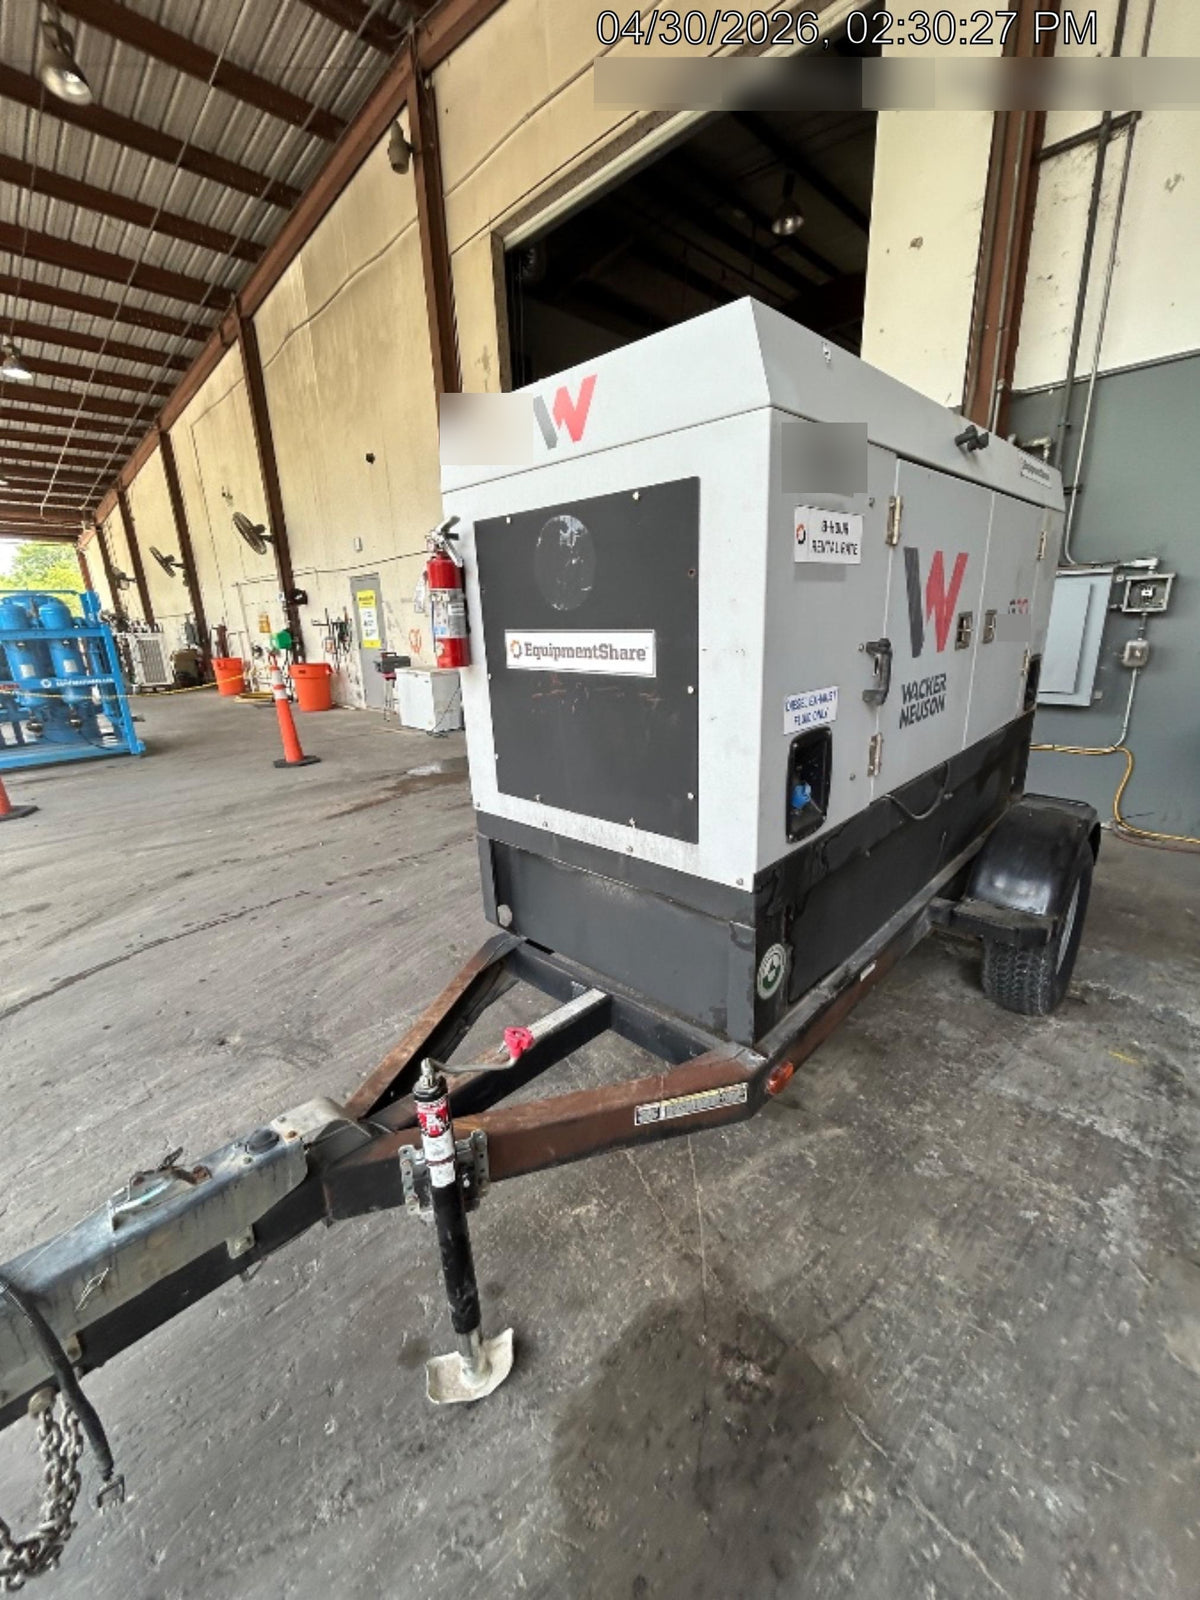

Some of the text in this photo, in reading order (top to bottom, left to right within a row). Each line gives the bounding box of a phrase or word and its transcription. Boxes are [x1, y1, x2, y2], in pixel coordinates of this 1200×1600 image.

[524, 642, 647, 662] EquipmentShare
[901, 673, 947, 705] WACKER
[899, 694, 946, 730] NEUSON
